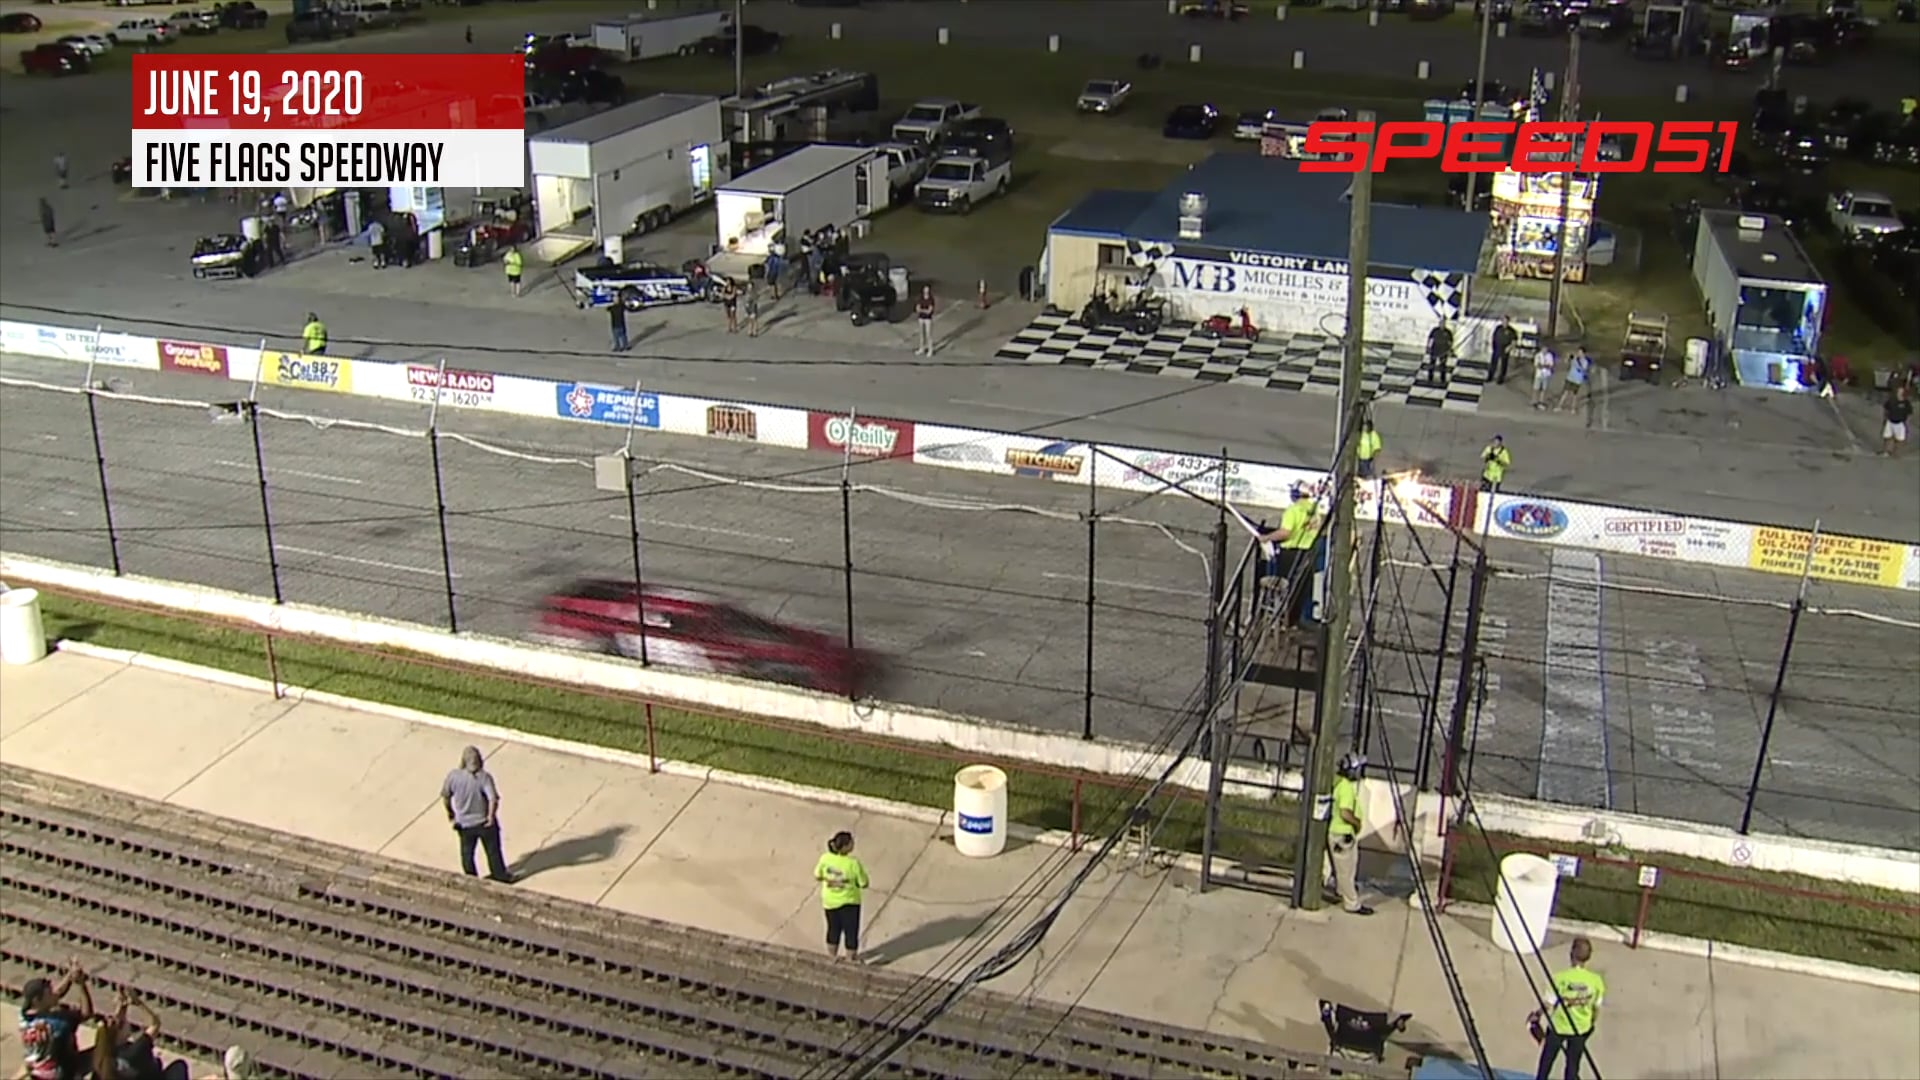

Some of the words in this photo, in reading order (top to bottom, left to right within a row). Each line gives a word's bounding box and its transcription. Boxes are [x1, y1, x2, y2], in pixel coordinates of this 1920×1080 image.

[1229, 251, 1307, 270] VICTORY
[1312, 261, 1349, 274] LAN
[1243, 268, 1323, 291] MICHLES
[1242, 286, 1297, 299] ACCIDENT
[1313, 293, 1346, 303] INJUR
[1365, 299, 1409, 310] AWYERS
[446, 373, 493, 392] RADIO
[410, 386, 436, 402] 92.3
[452, 391, 480, 406] 1620
[829, 420, 893, 449] O'Reilly
[1606, 518, 1683, 533] CERTIFIED
[1759, 529, 1787, 541] FULL
[1757, 537, 1779, 548] OIL
[1762, 548, 1807, 561] 479-TIR
[1839, 568, 1880, 581] SERVICE
